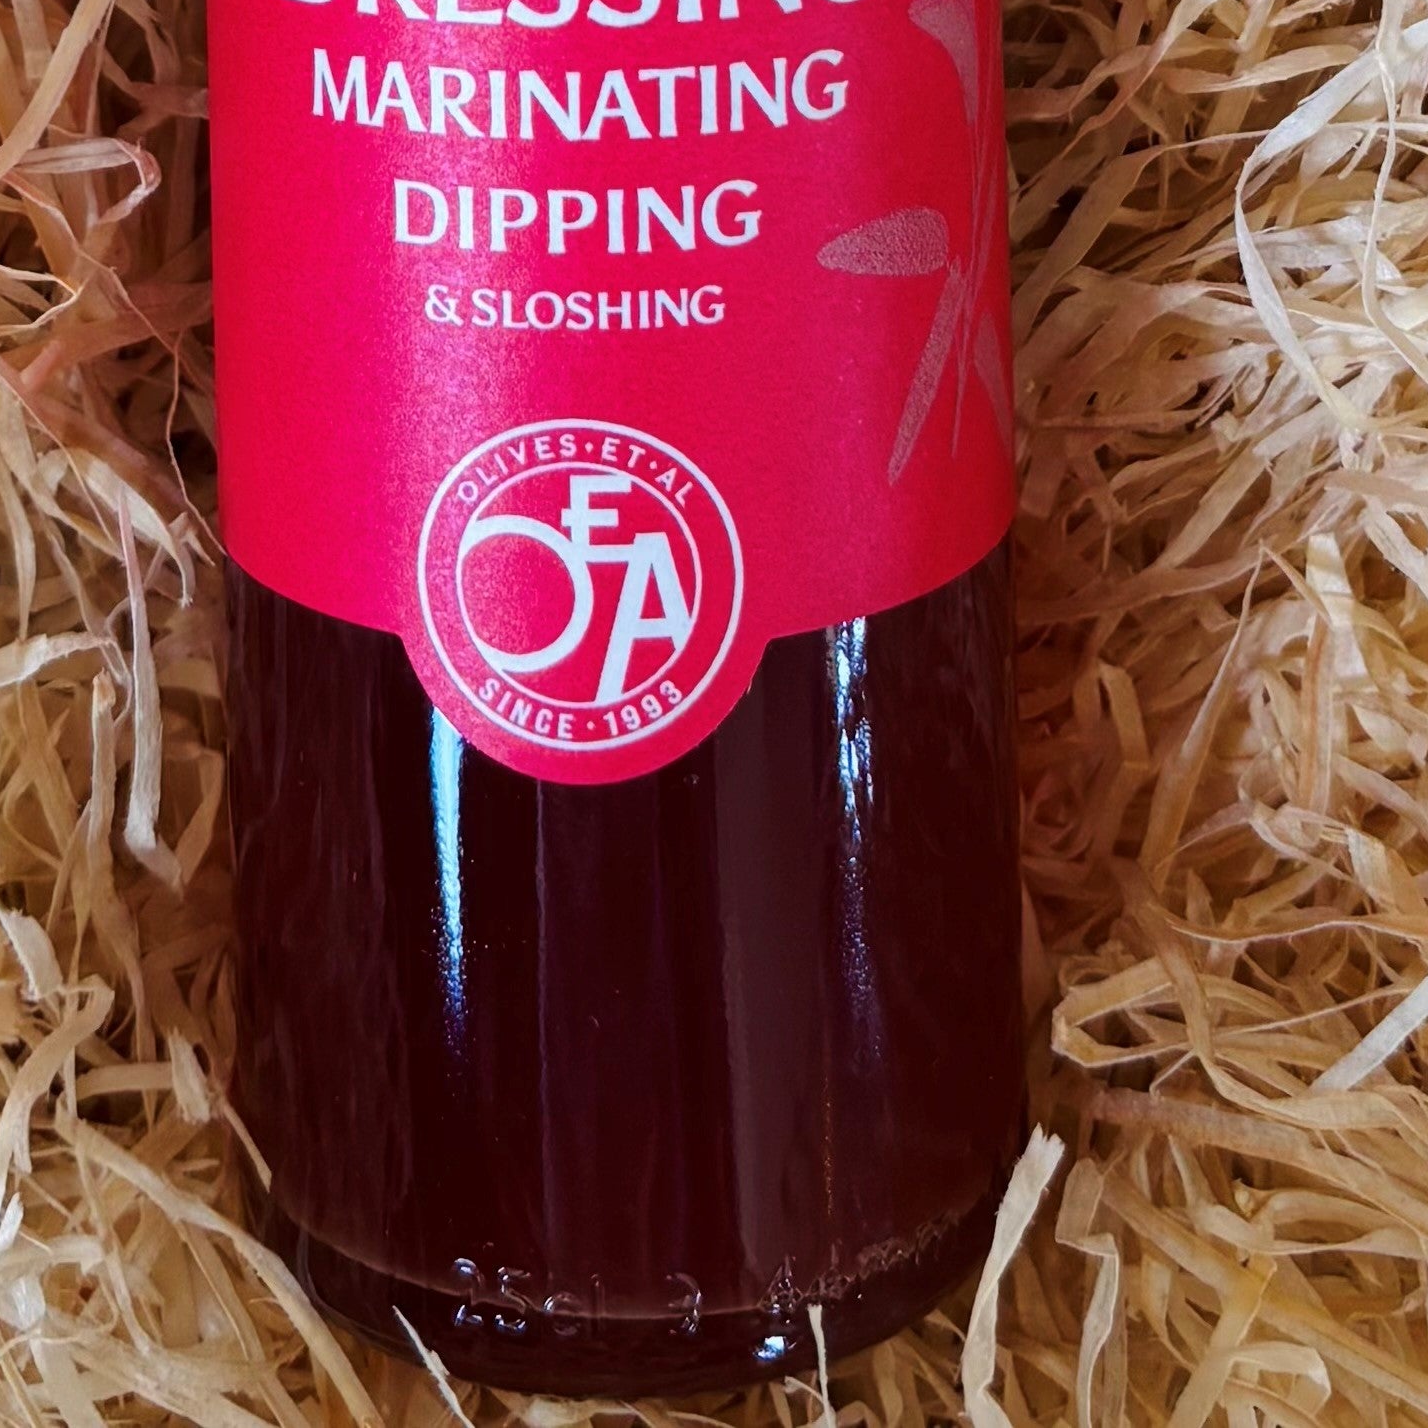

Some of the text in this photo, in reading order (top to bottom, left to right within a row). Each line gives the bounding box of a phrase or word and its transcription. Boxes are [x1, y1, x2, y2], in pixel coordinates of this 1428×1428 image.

[310, 47, 850, 142] MARINATING
[393, 177, 763, 255] DIPPING
[424, 283, 727, 332] & SLOSHING
[457, 432, 699, 509] OLIVES ET AL
[478, 676, 684, 740] SINCE 1993
